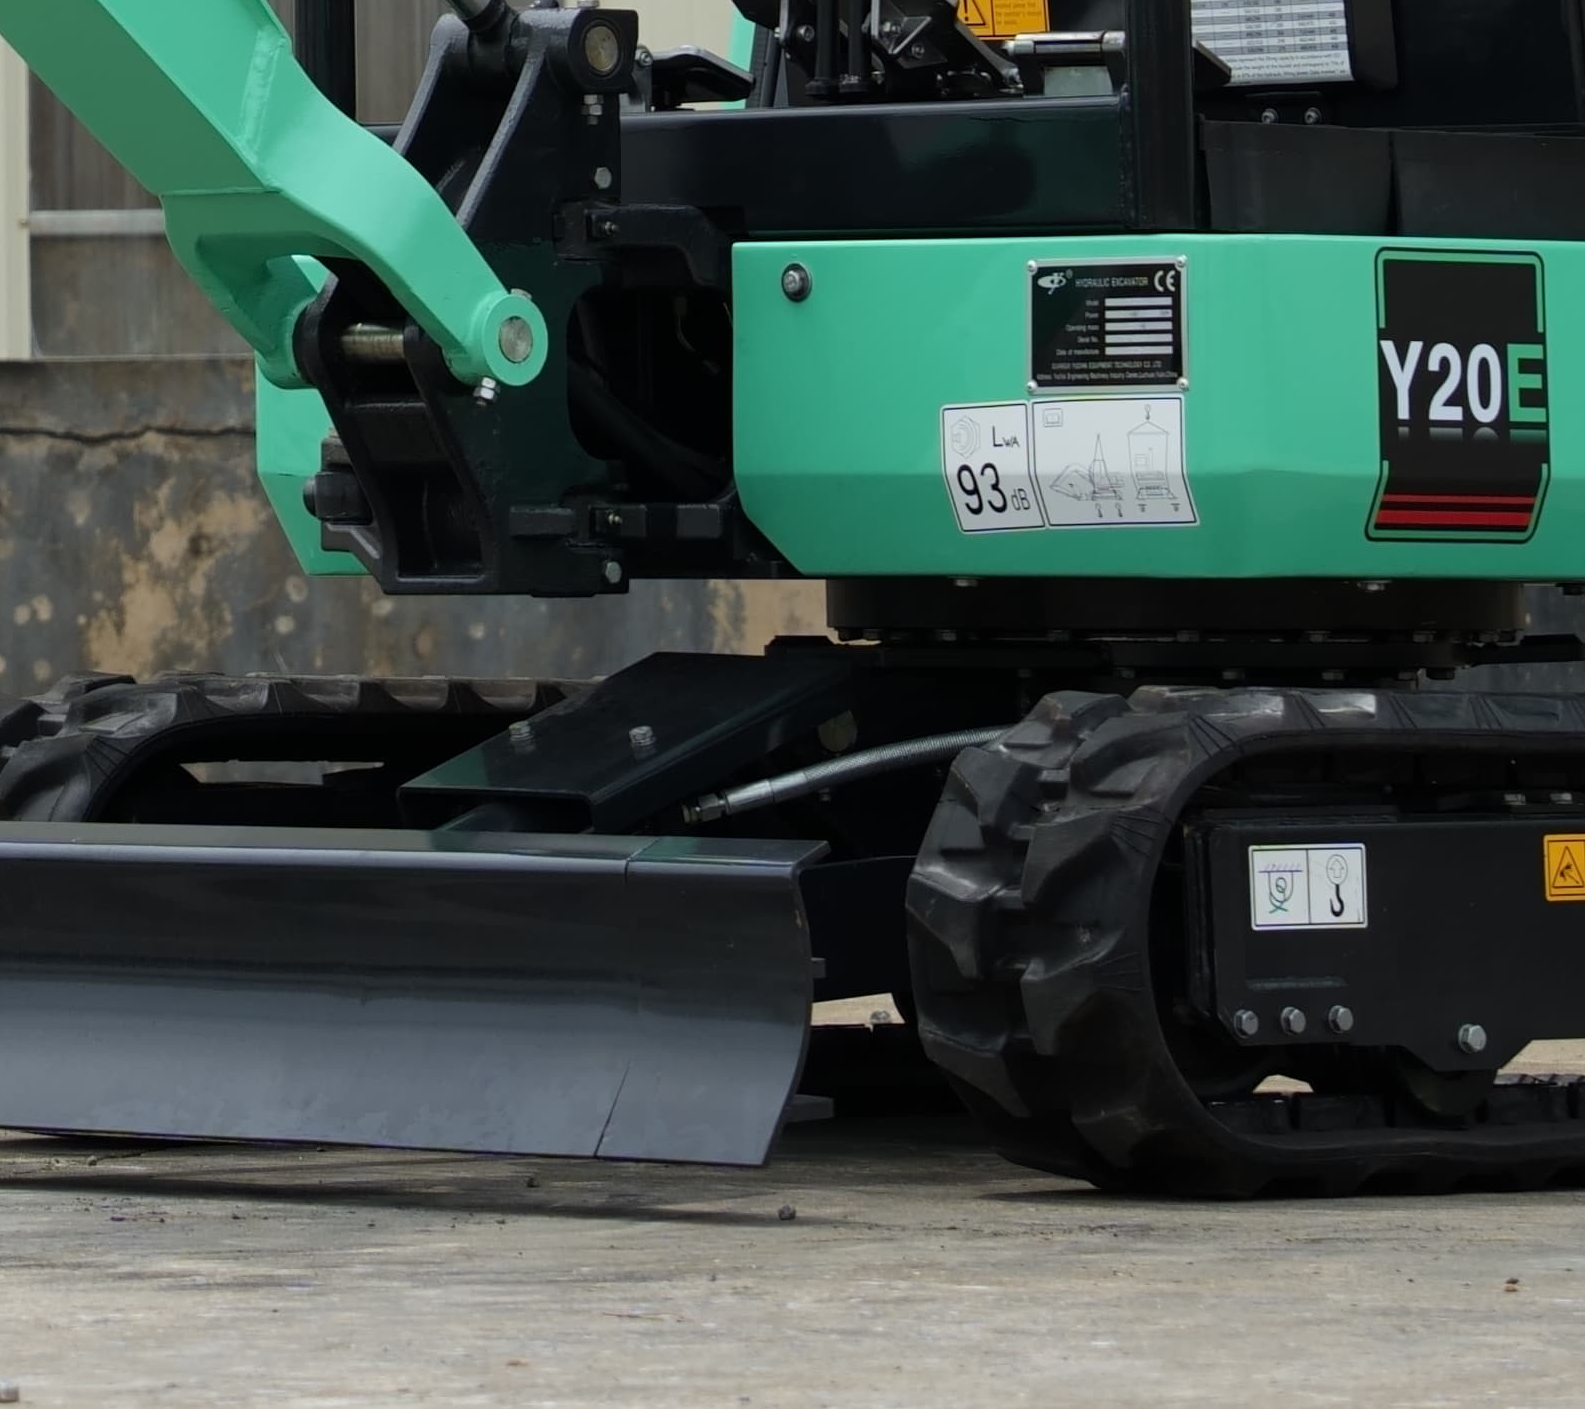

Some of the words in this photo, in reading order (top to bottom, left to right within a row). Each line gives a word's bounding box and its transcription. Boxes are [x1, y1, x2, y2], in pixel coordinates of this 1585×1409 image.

[1154, 269, 1176, 292] CE
[1380, 340, 1547, 424] Y20E
[957, 463, 1008, 516] 93
[1011, 488, 1031, 511] dB
